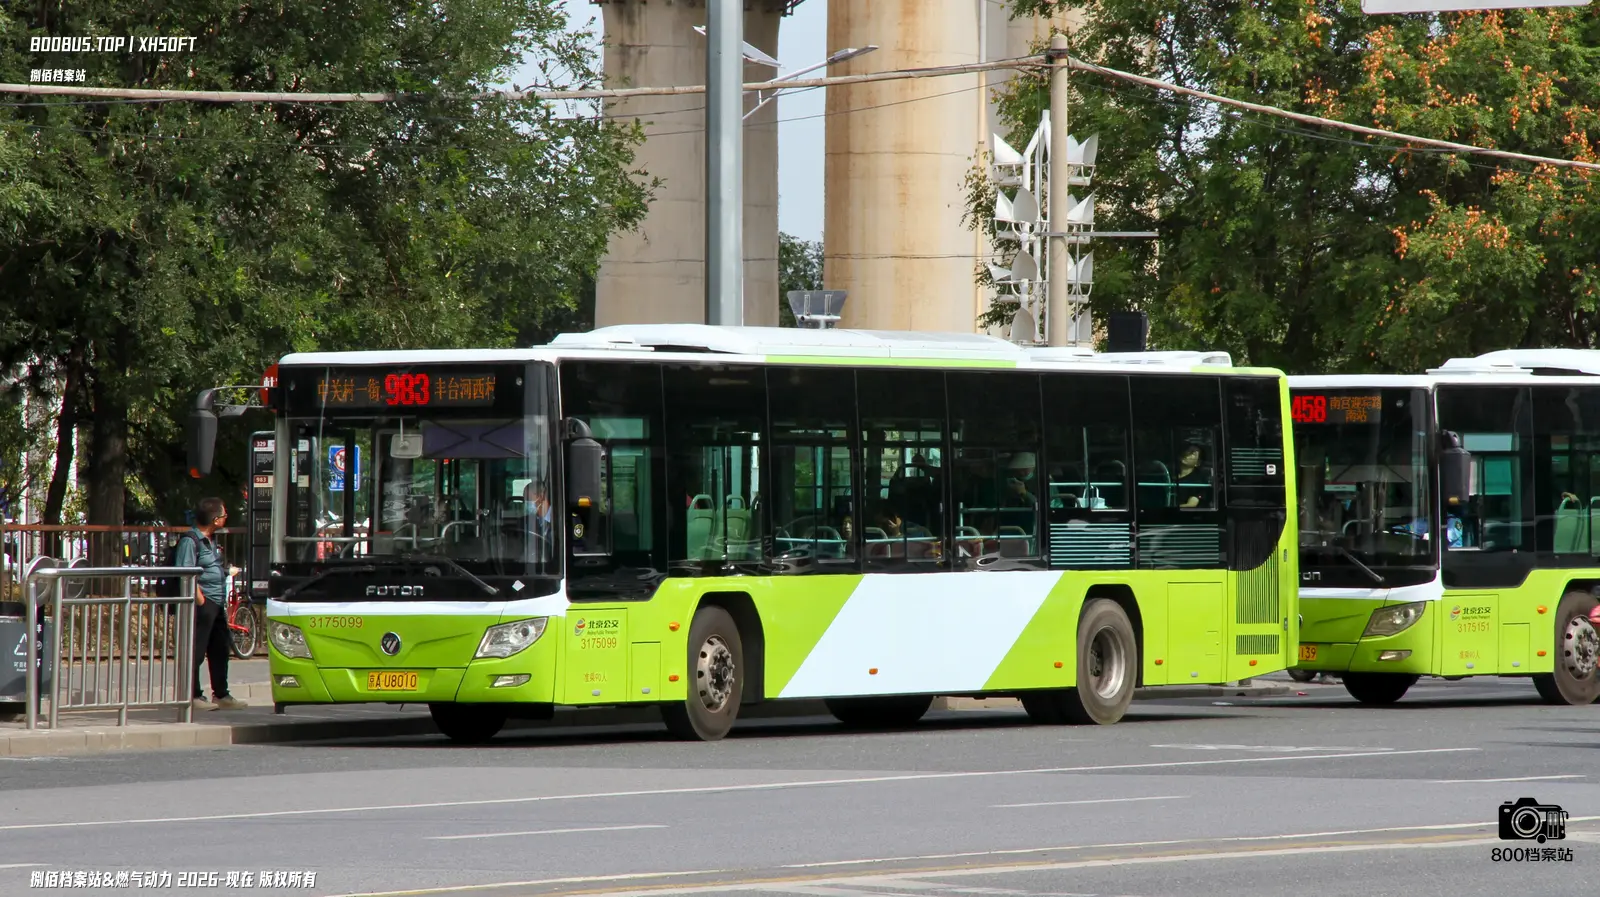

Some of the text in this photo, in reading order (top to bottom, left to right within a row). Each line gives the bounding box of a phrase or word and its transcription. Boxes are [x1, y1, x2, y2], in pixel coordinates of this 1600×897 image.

[384, 373, 430, 405] 983
[434, 376, 496, 400] 丰台河西村
[1291, 396, 1326, 422] 458
[366, 585, 424, 596] FOTON
[309, 616, 363, 629] 3175099
[588, 619, 619, 629] 北京公交
[1457, 622, 1490, 633] 3175151
[581, 637, 617, 649] 3175099
[1298, 646, 1317, 659] 139
